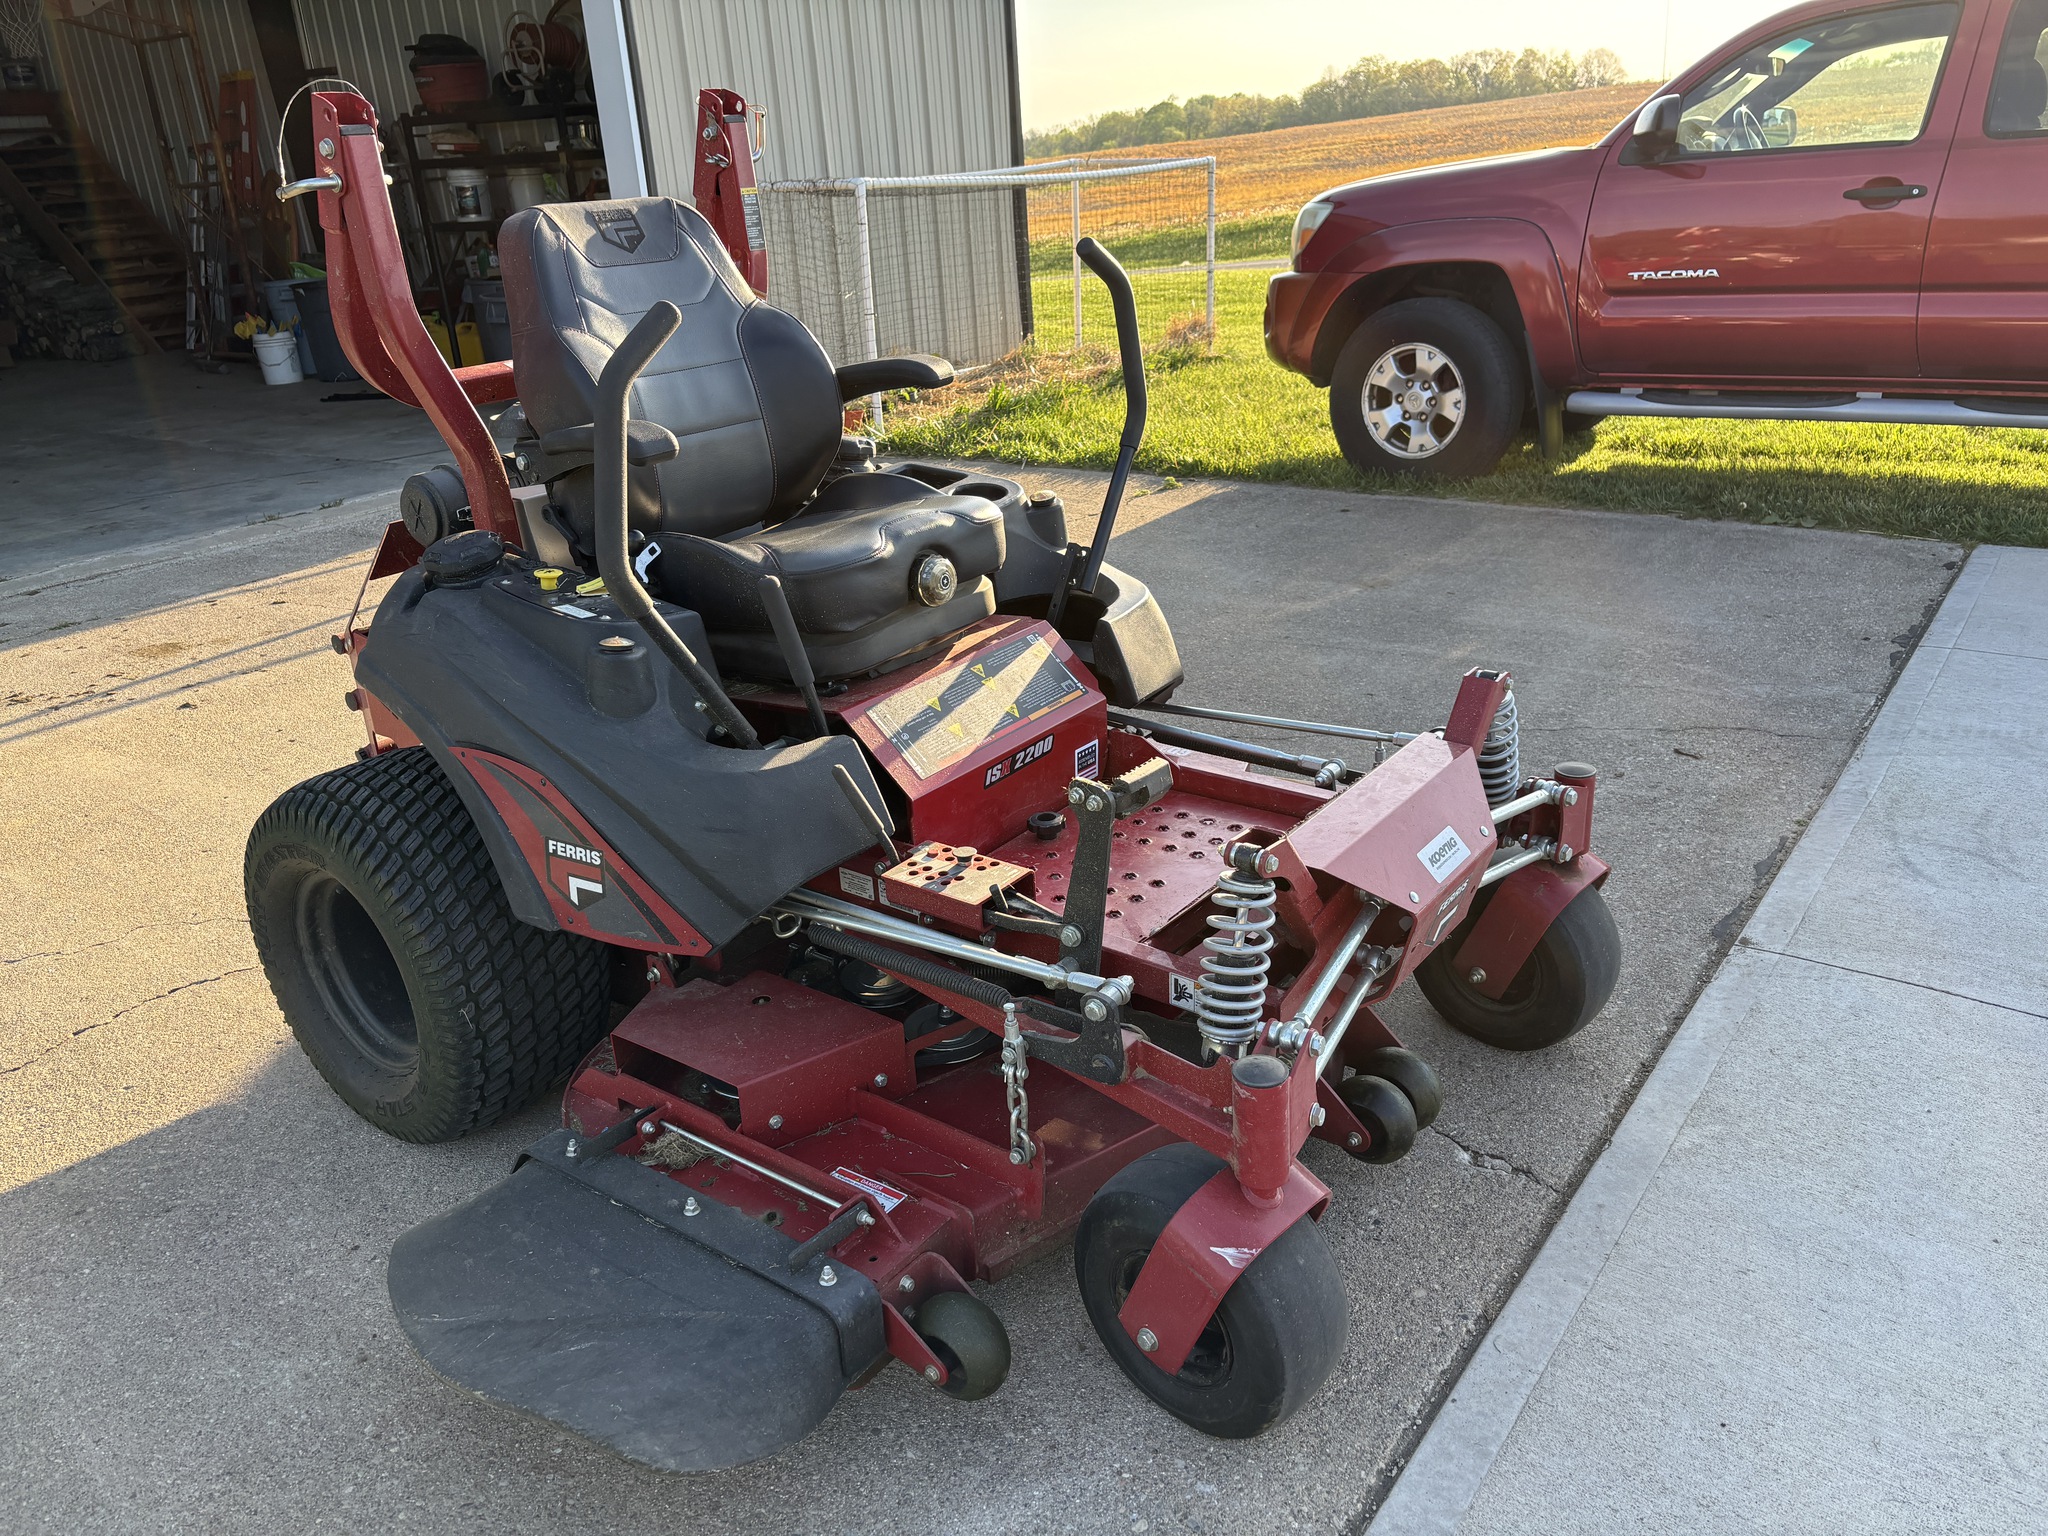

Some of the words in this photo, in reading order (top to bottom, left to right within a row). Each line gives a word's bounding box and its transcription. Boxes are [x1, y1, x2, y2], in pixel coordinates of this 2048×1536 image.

[1627, 268, 1720, 281] TACOMA
[985, 757, 1012, 786] ISX
[1014, 735, 1054, 770] 2200
[549, 839, 601, 866] FERRIS
[1437, 879, 1469, 915] FERRIS
[860, 1179, 884, 1191] DANGER
